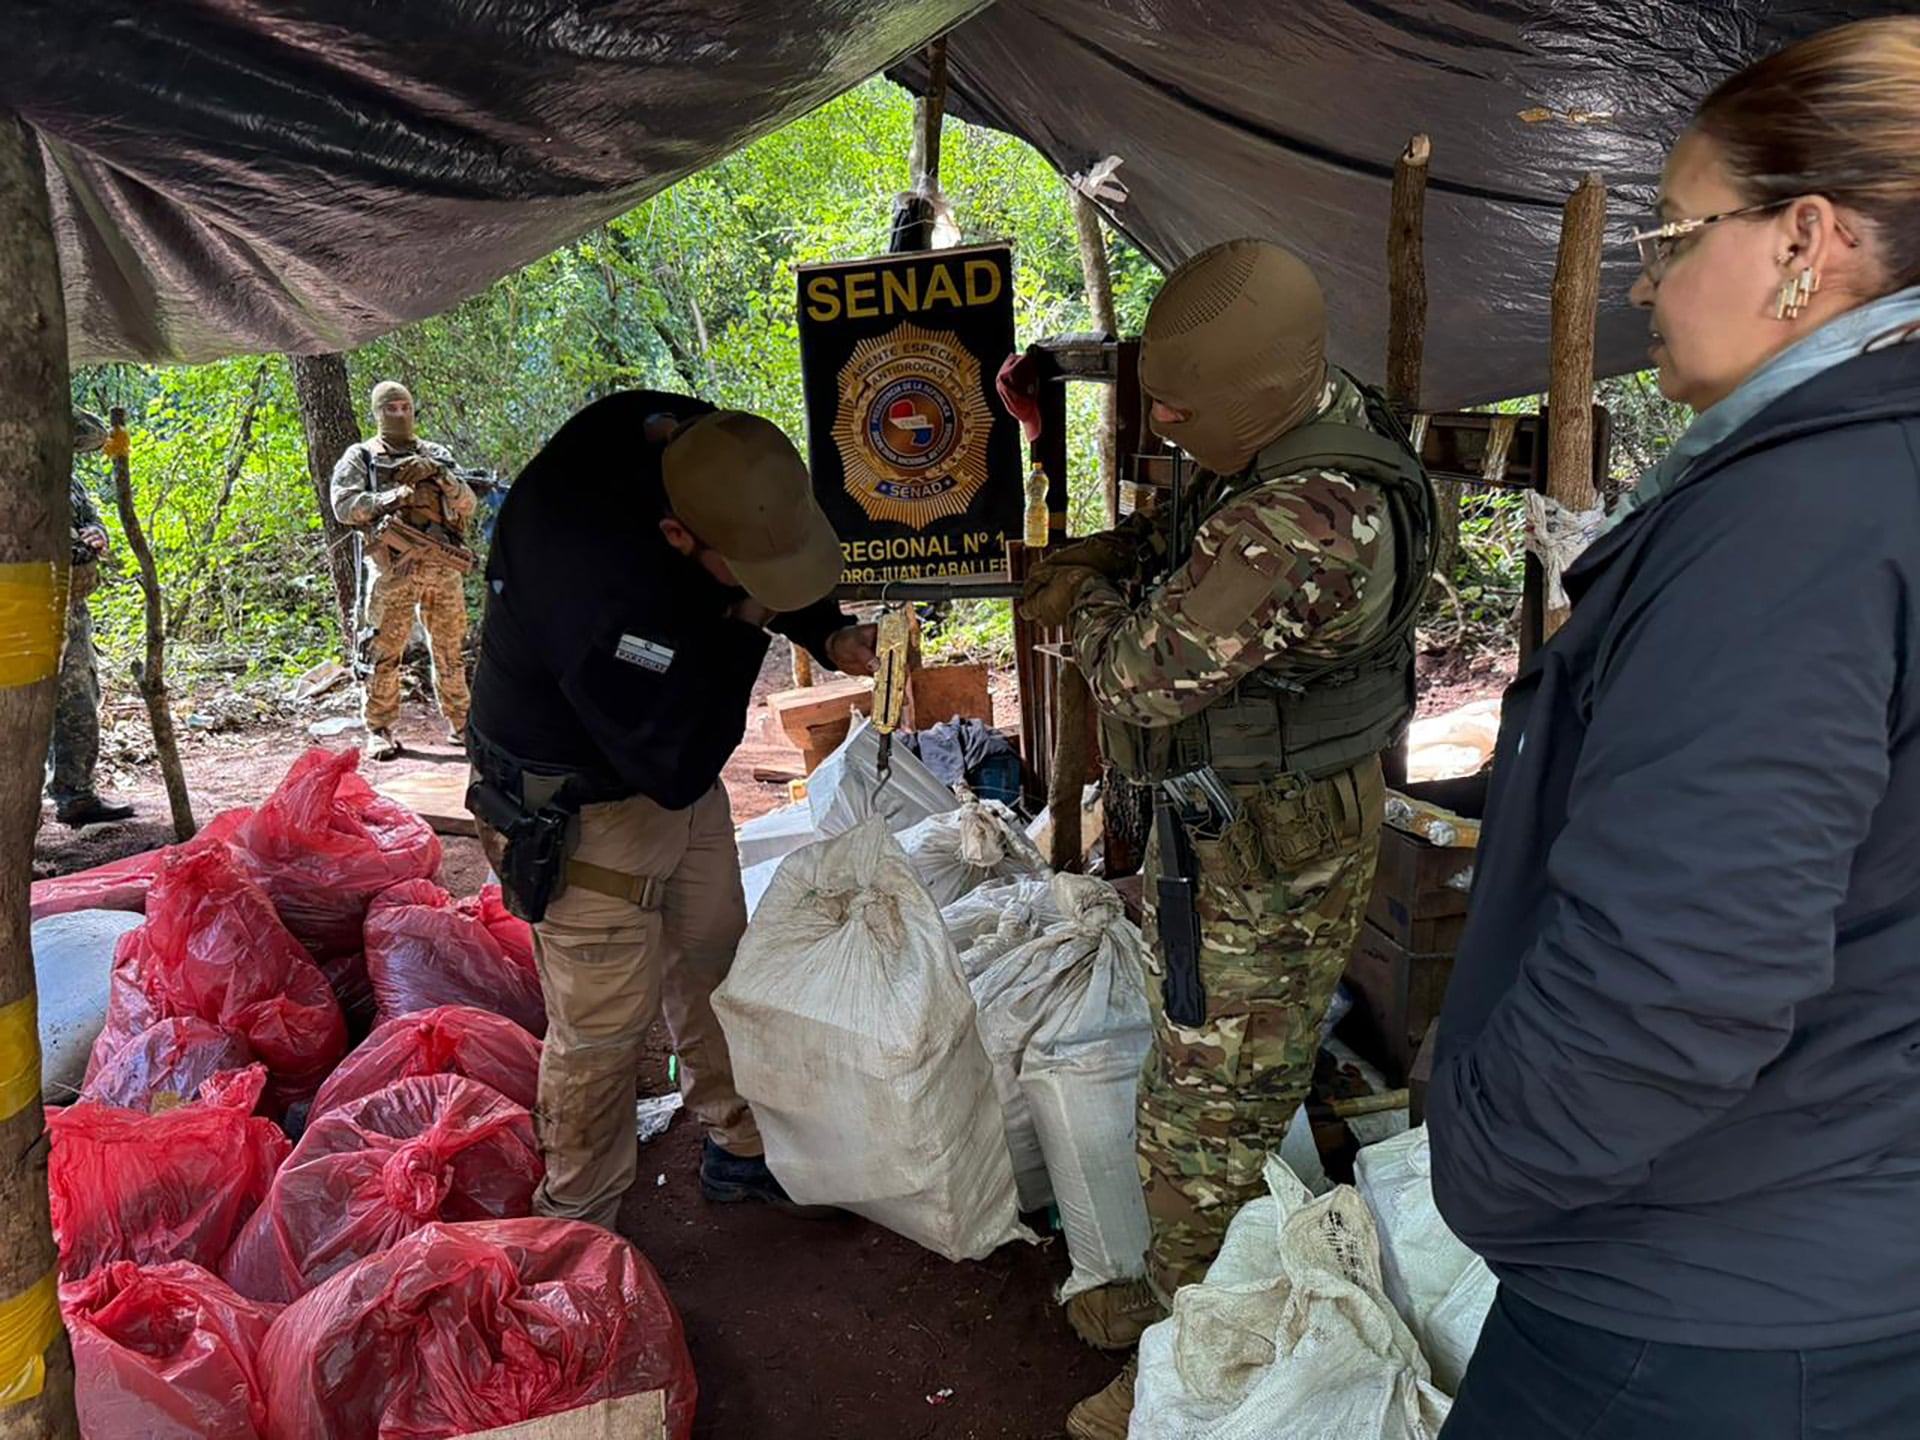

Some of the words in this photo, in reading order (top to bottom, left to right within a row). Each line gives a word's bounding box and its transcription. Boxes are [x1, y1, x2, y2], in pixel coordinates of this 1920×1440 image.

[807, 259, 1001, 321] SENAD
[853, 346, 898, 380] AGENTE
[903, 343, 962, 369] ESPECIAL
[872, 362, 945, 385] ANTIDROGAS
[890, 482, 942, 498] SENAD
[840, 535, 957, 562] REGIONAL
[996, 530, 1005, 551] 1
[840, 567, 875, 583] DRO
[879, 563, 920, 582] JUAN
[926, 558, 1008, 577] CABALLER
